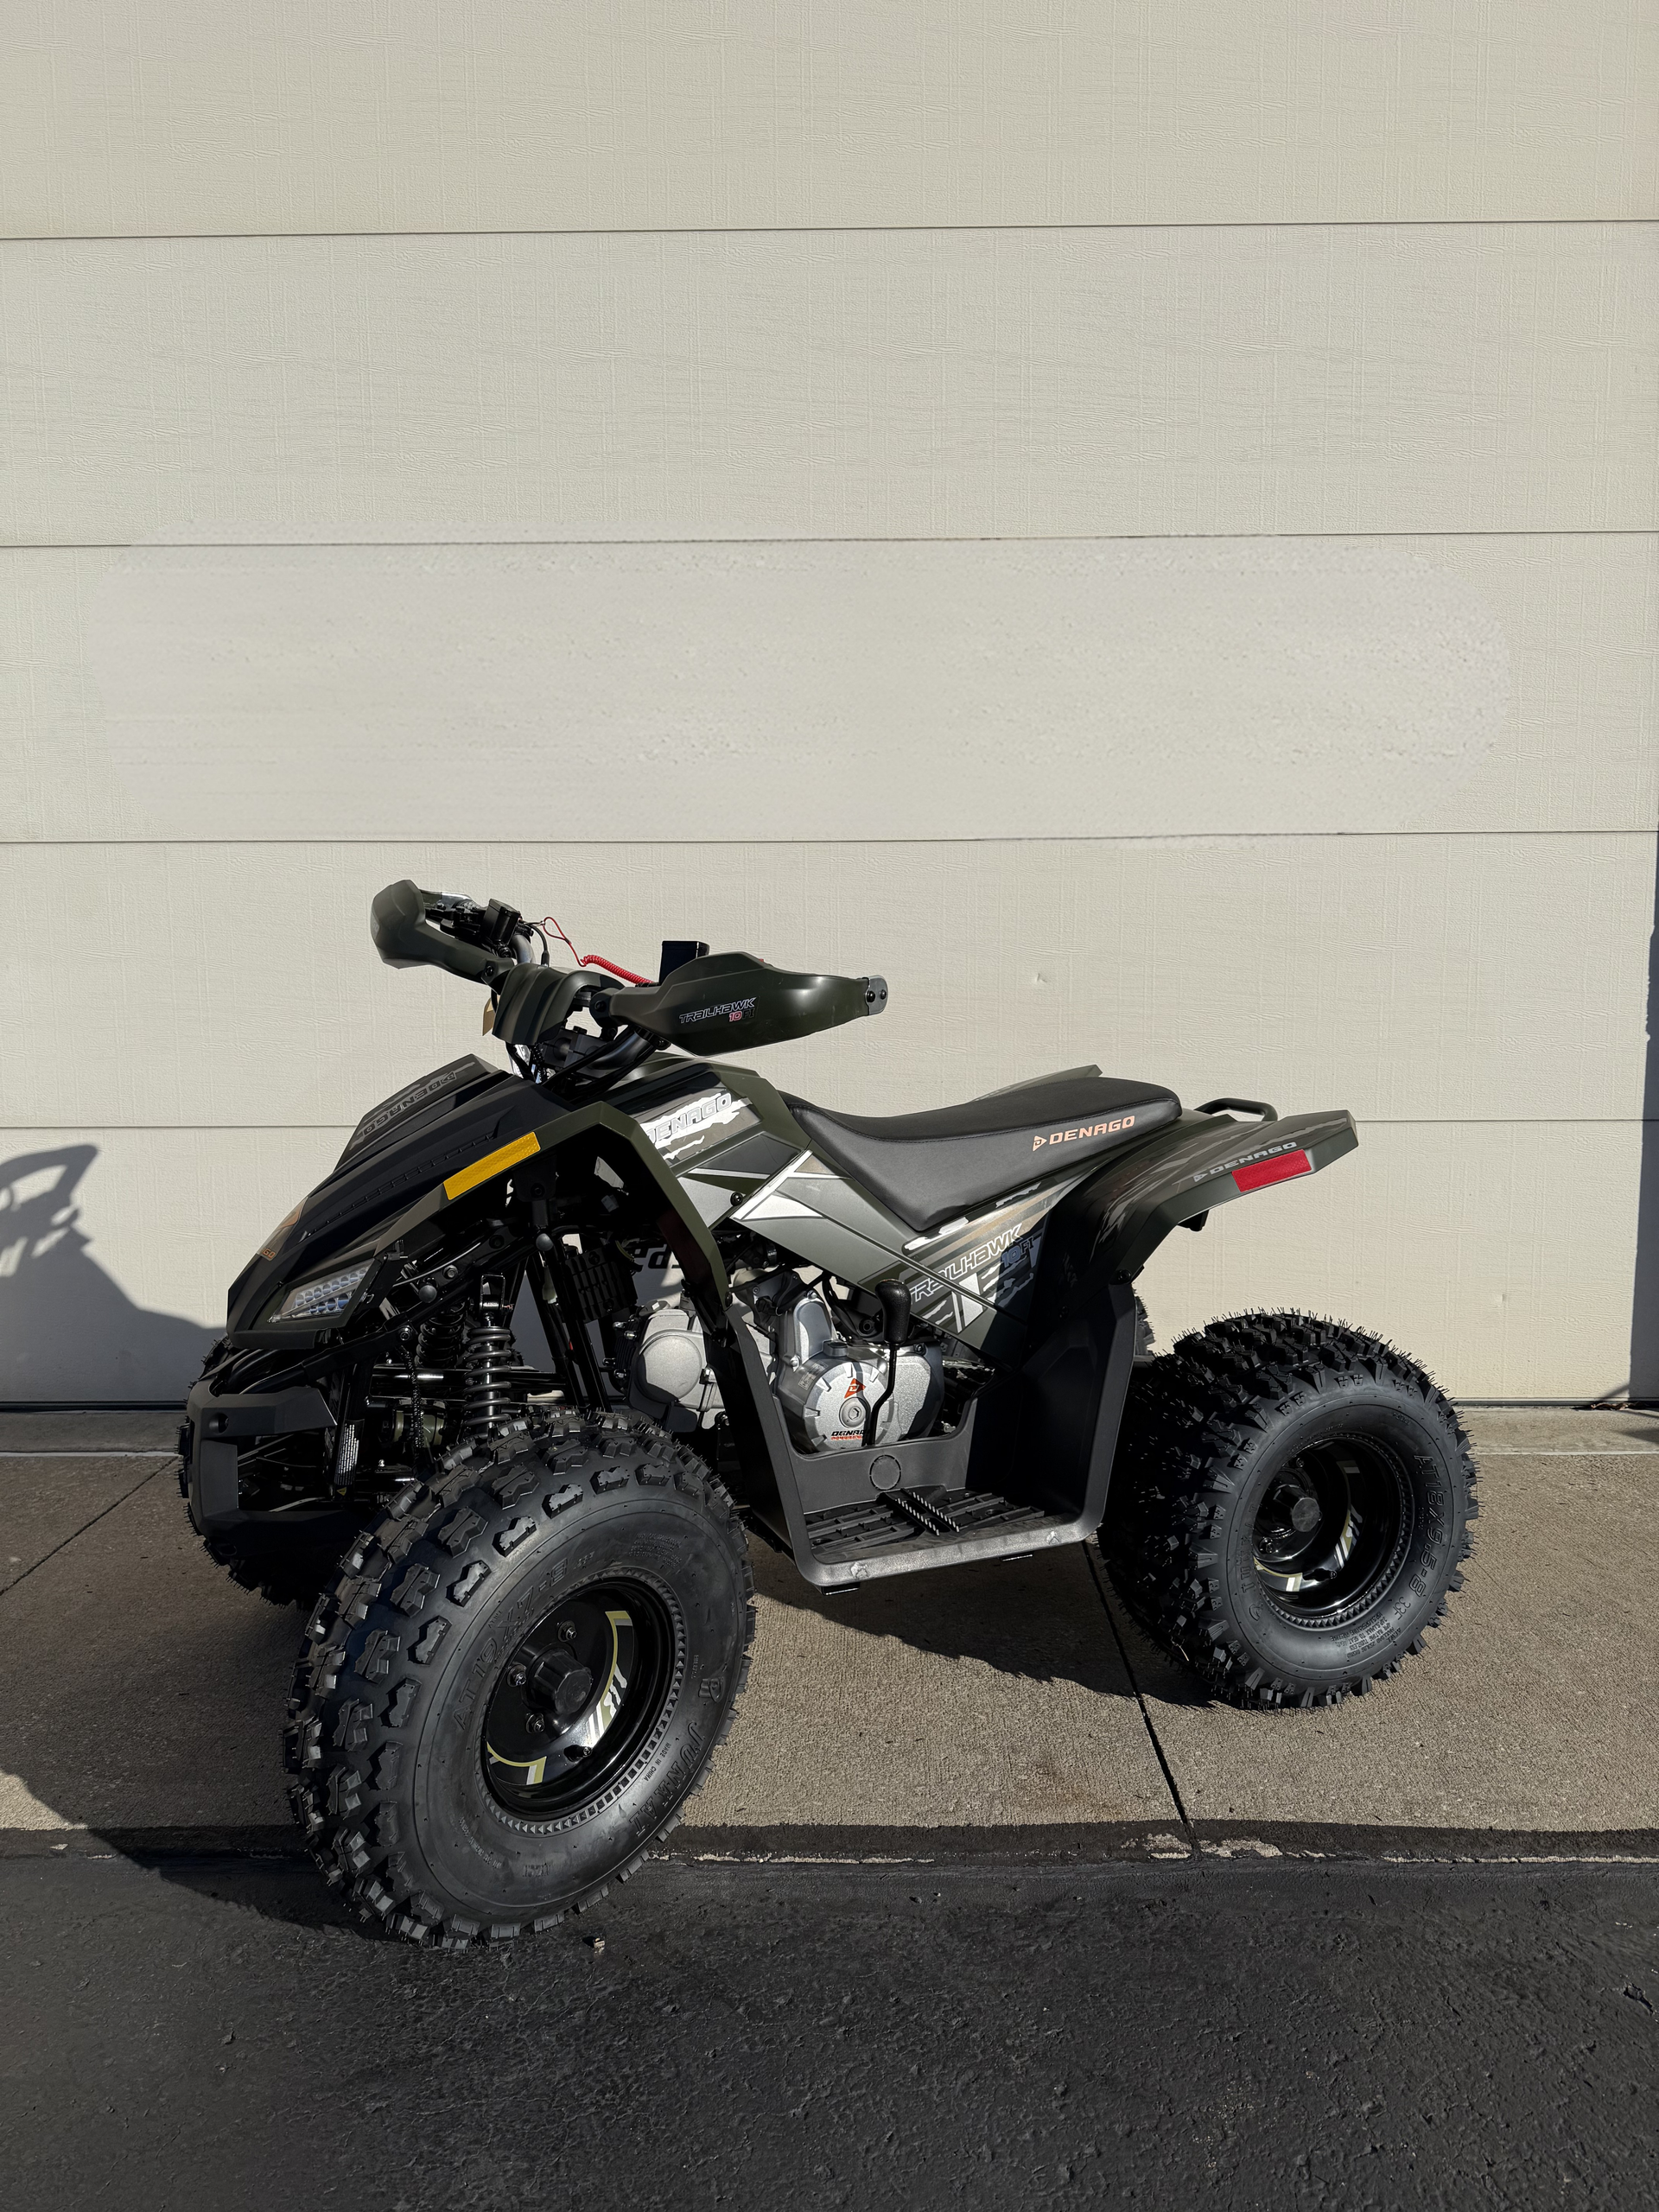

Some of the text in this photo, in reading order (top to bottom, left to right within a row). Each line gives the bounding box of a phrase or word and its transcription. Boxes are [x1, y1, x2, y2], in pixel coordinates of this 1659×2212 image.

[363, 1080, 442, 1136] DENAGO
[1049, 1116, 1135, 1145] DENAGO
[1210, 1141, 1298, 1175] DENAGO
[659, 1742, 671, 1758] MADE
